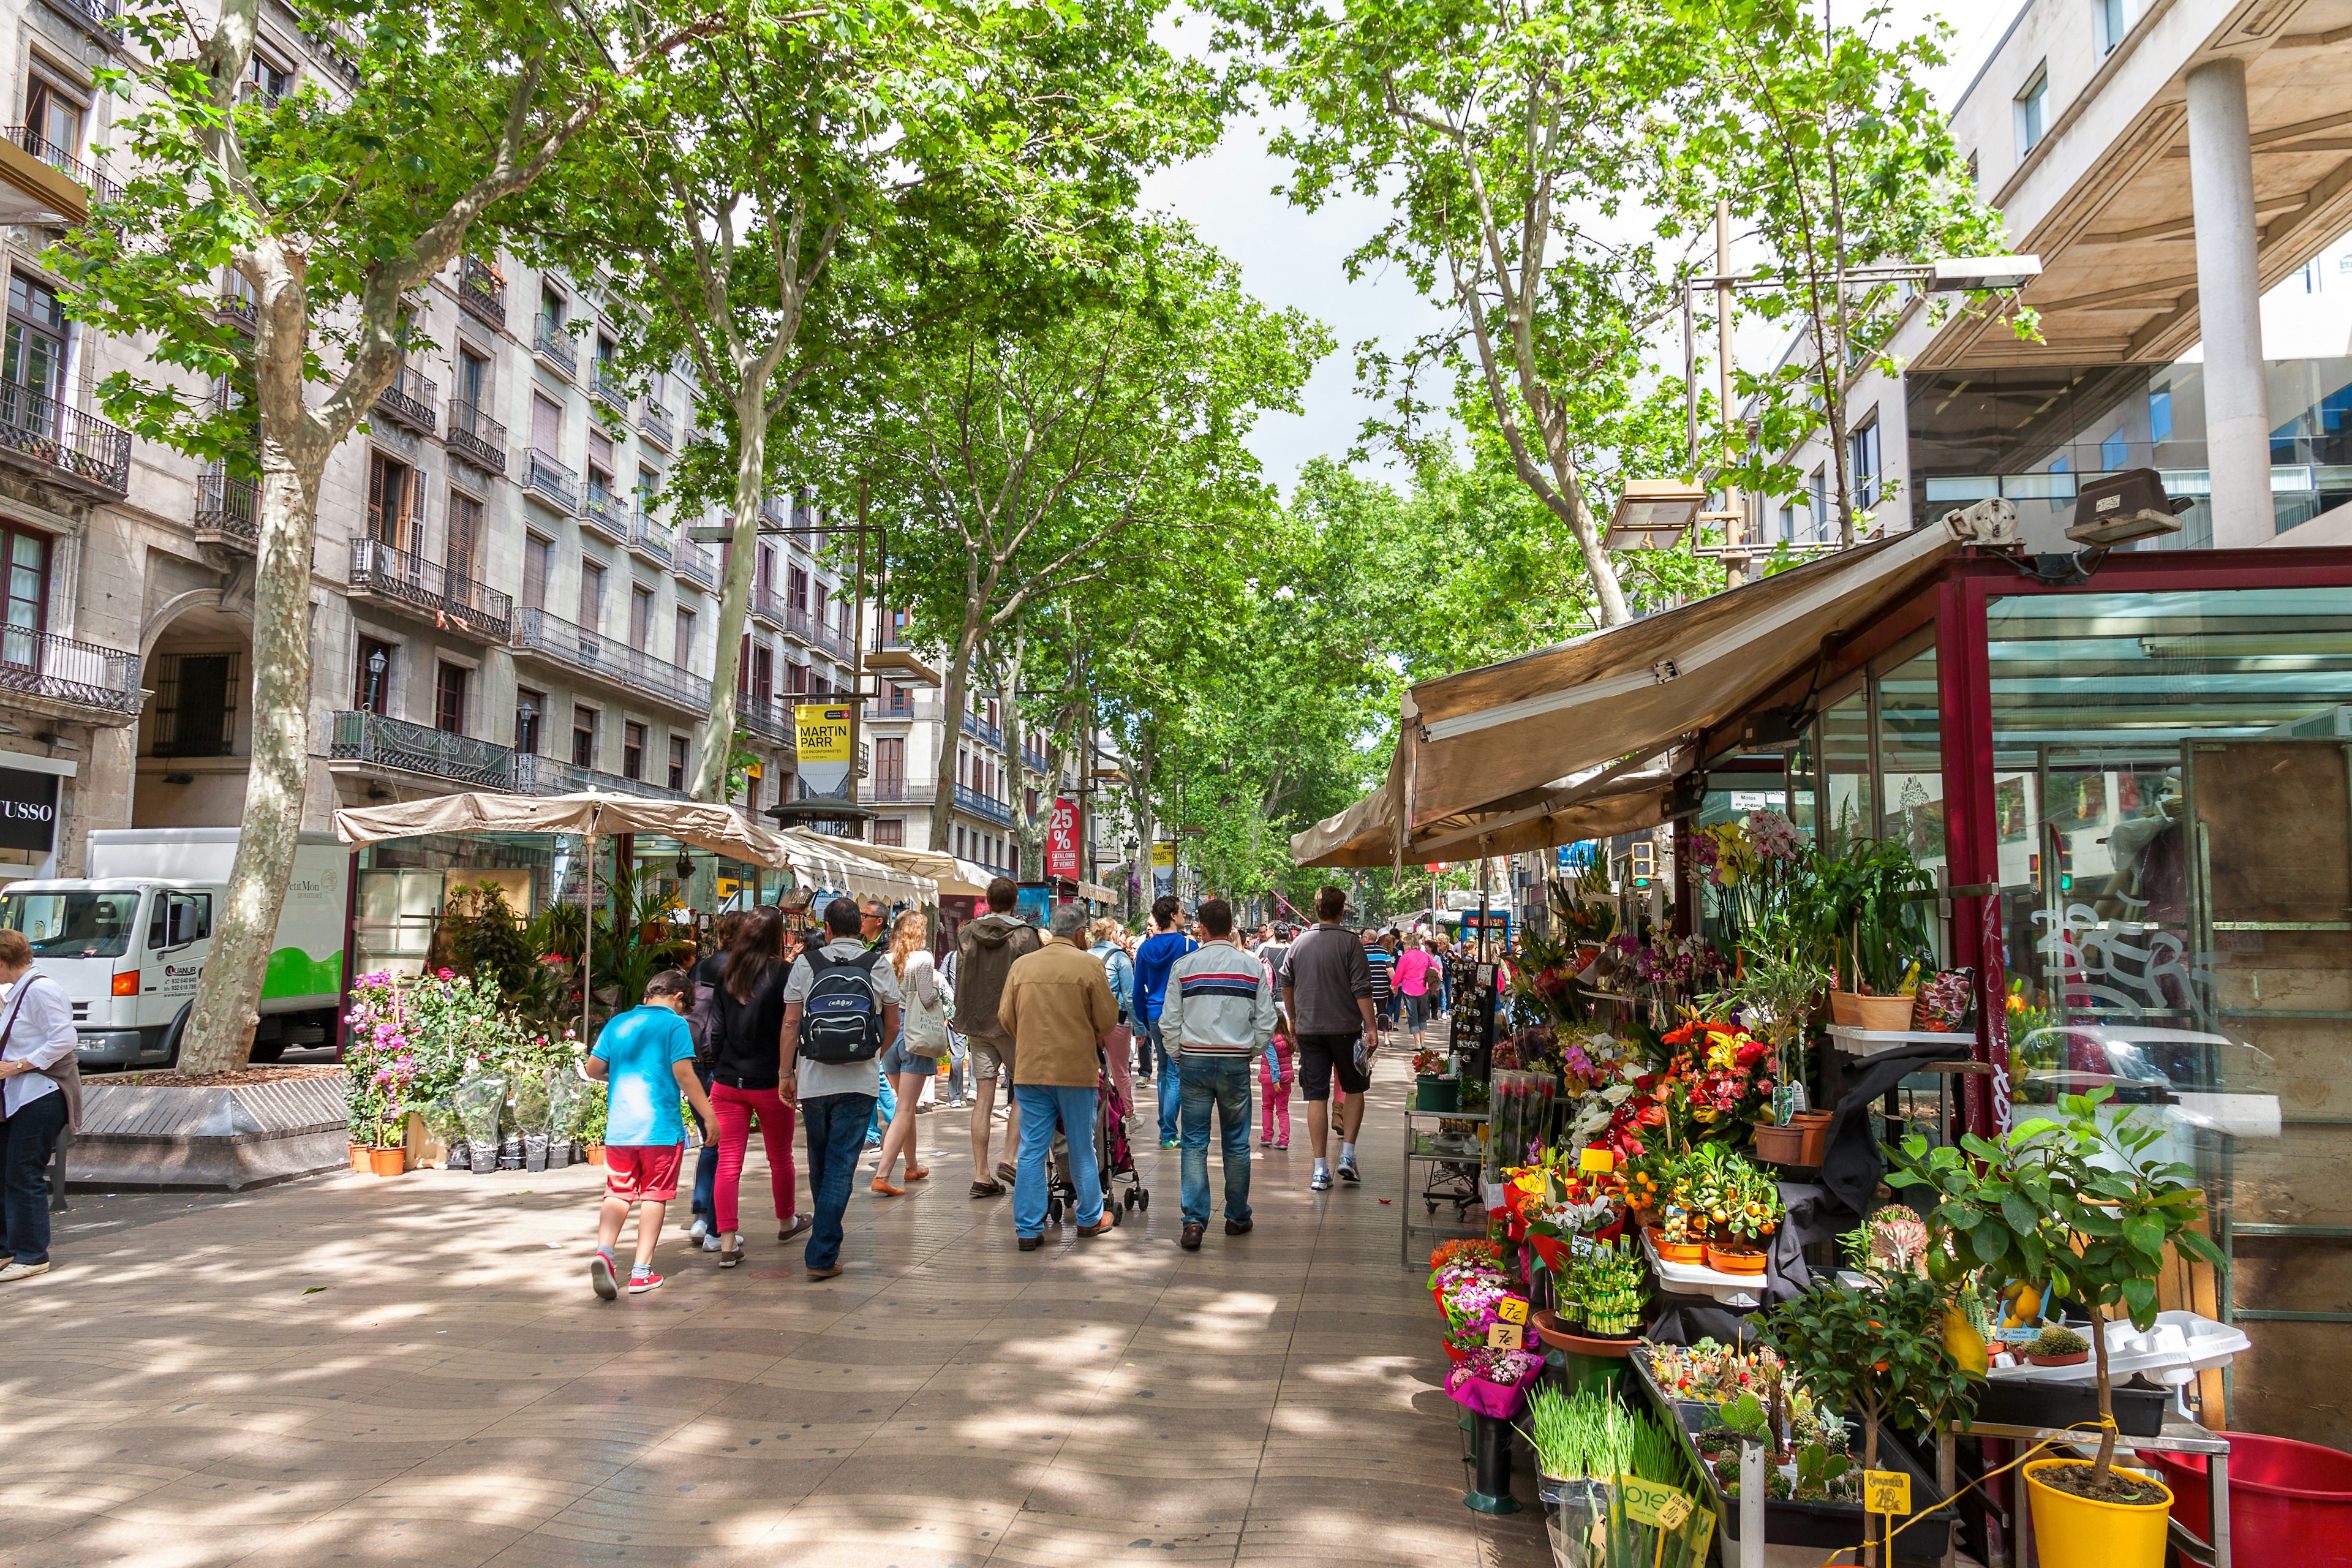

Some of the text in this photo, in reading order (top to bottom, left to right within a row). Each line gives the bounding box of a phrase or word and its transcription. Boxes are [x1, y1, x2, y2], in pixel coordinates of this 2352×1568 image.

[801, 726, 846, 737] MARTIN
[801, 737, 832, 748] PARR
[1050, 809, 1072, 829] 25
[1054, 829, 1071, 850] %
[288, 881, 320, 891] etitMón
[1505, 1302, 1521, 1320] 7€
[1498, 1330, 1513, 1346] 7€
